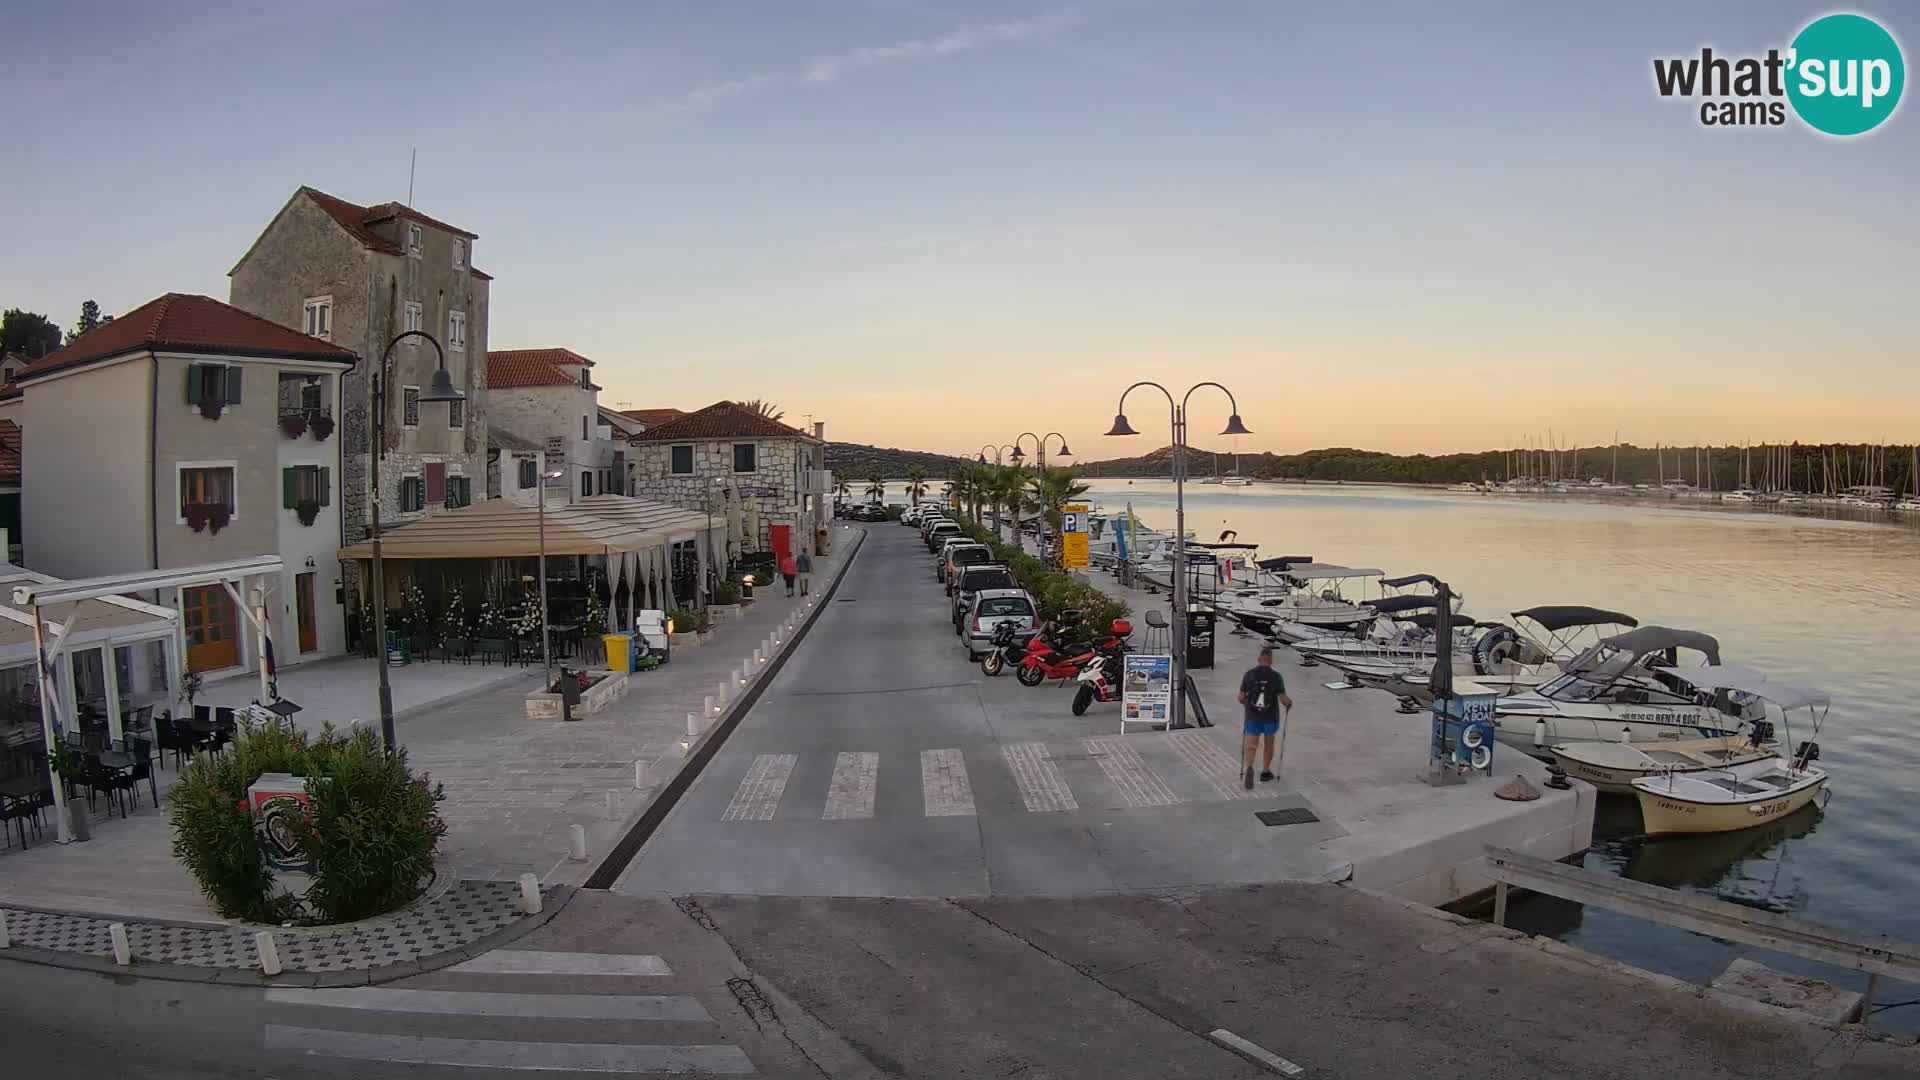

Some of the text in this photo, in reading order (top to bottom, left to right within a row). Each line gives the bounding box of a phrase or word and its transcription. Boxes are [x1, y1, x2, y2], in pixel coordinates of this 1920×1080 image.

[1065, 514, 1076, 531] P
[1463, 701, 1495, 713] RENT
[1463, 711, 1495, 722] A BOAT
[1655, 713, 1675, 723] RENT
[1675, 713, 1681, 723] A
[1682, 714, 1701, 726] BOAT
